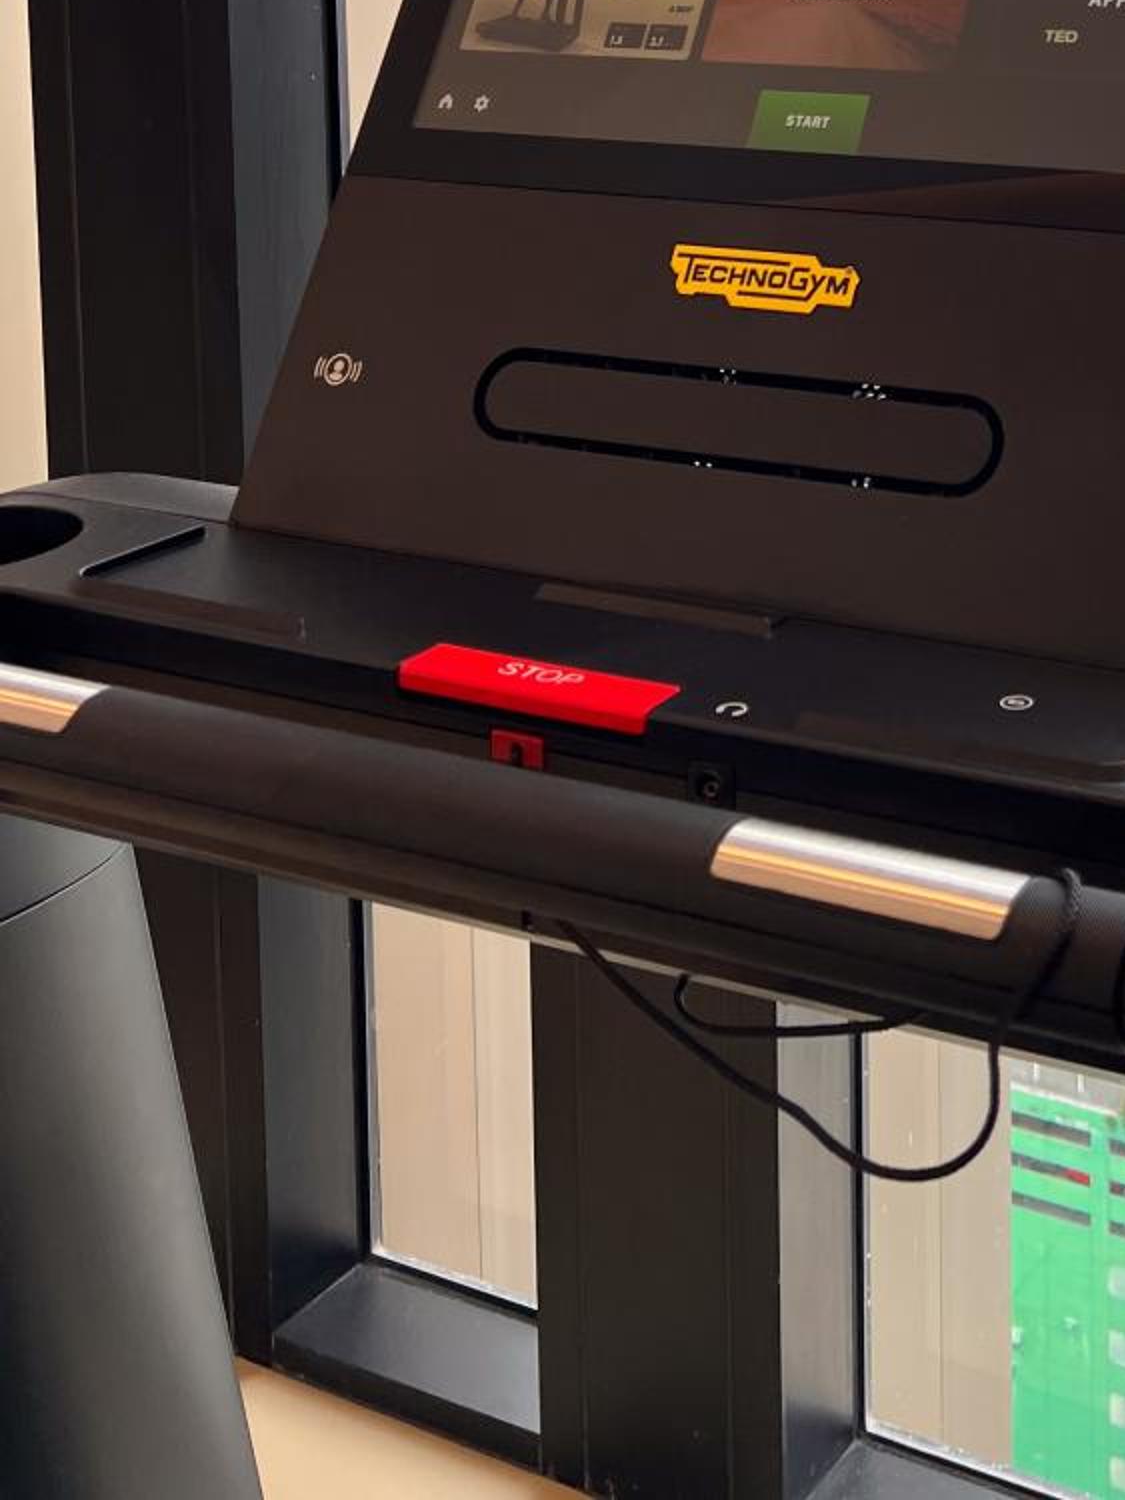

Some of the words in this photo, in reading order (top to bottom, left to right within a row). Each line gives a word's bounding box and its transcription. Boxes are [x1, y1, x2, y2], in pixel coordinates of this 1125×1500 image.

[1044, 29, 1079, 44] TED
[785, 115, 831, 129] START
[497, 661, 585, 685] STOP
